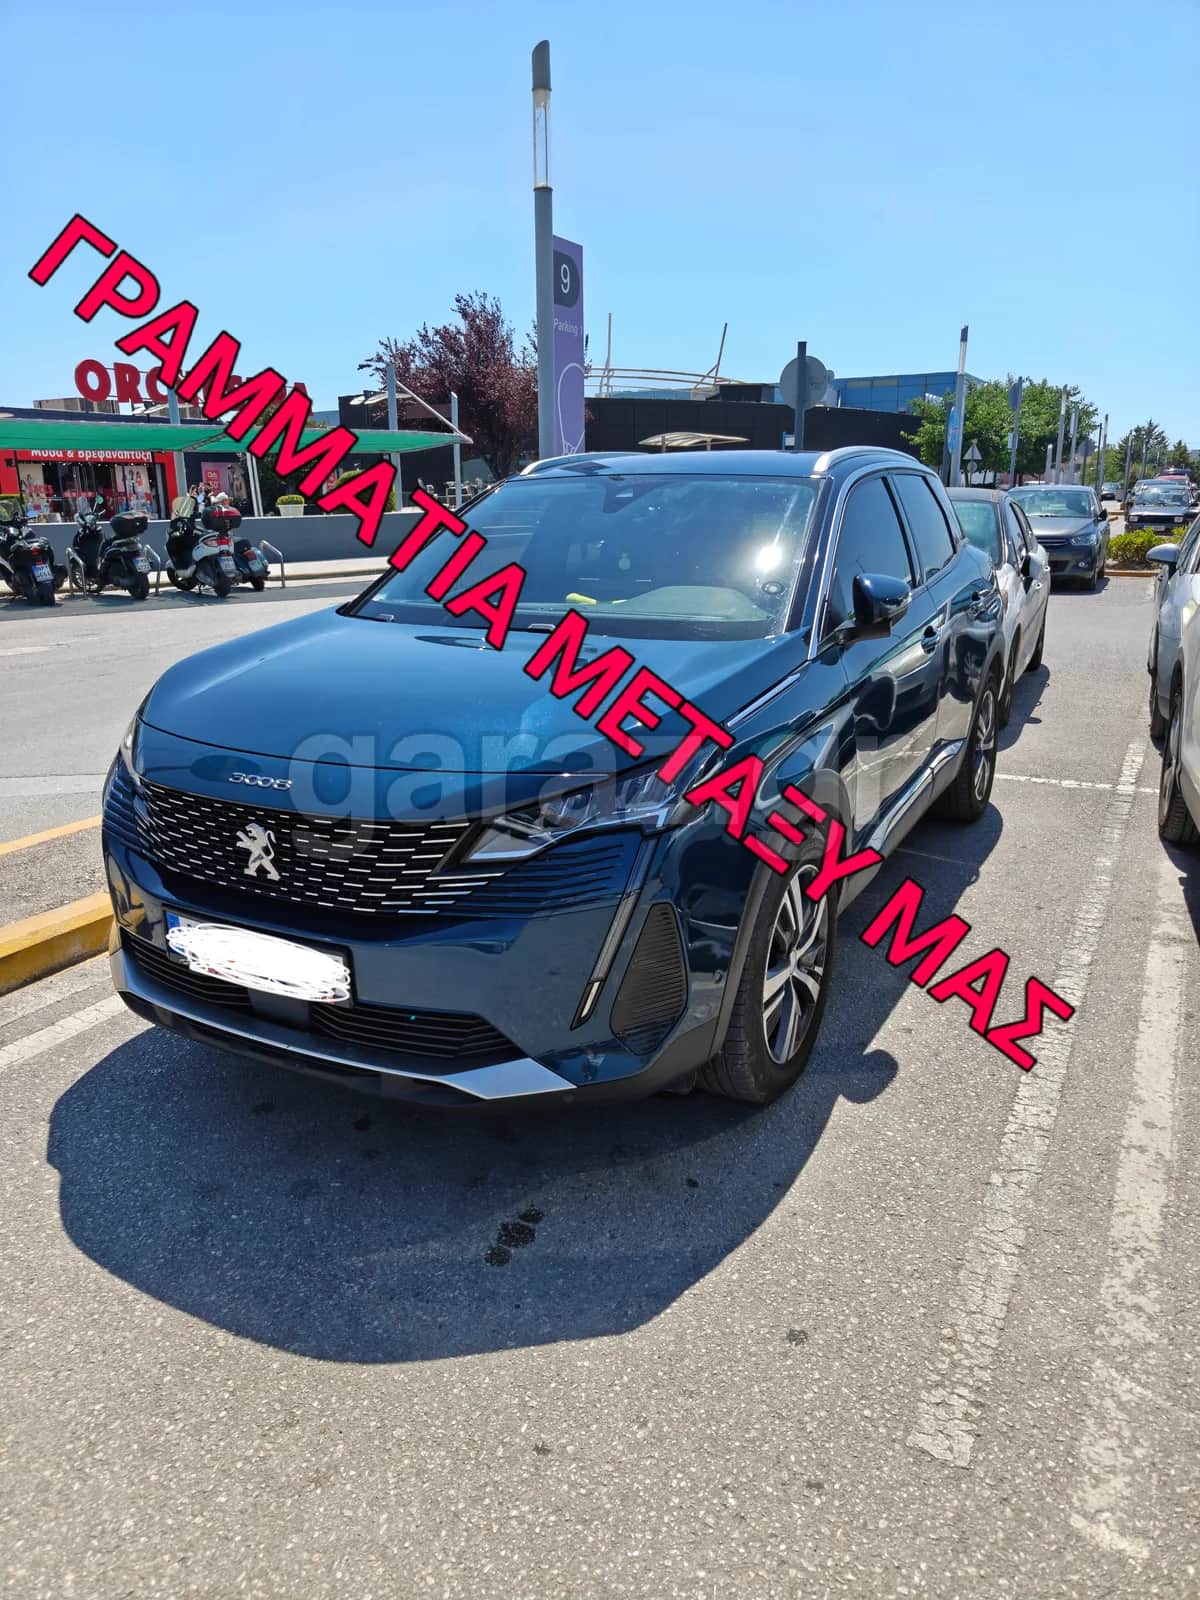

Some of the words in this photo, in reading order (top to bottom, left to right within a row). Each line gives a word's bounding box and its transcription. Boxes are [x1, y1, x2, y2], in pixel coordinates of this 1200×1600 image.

[560, 264, 571, 294] 9
[553, 317, 578, 337] Parking
[228, 772, 292, 790] 3008
